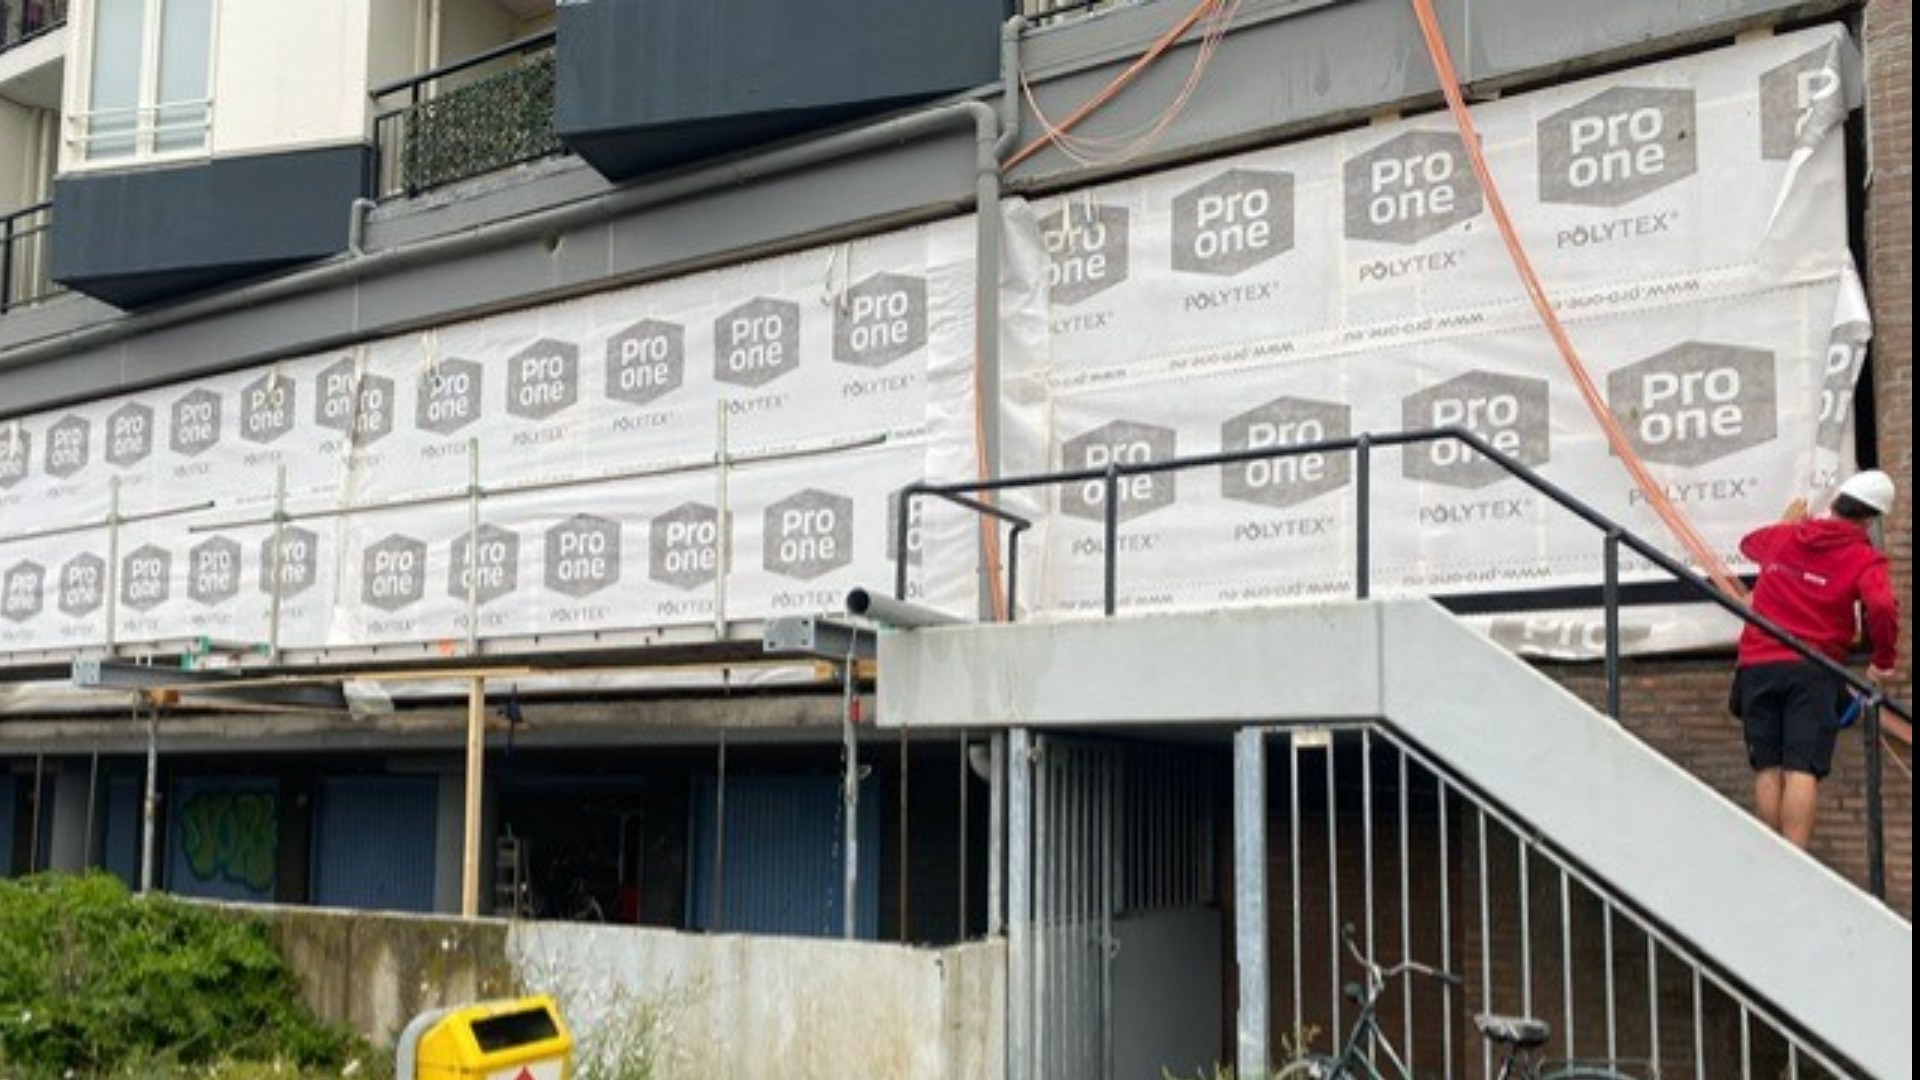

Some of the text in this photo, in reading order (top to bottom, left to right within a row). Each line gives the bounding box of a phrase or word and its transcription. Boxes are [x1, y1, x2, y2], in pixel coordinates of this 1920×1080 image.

[1568, 143, 1665, 187] one
[1367, 184, 1455, 224] one
[1193, 219, 1271, 258] one
[850, 319, 908, 351] one
[729, 341, 782, 371] one
[620, 362, 669, 391] one
[519, 381, 564, 406] one
[427, 397, 470, 420] one
[1640, 404, 1743, 445] one
[1245, 453, 1326, 487] one
[665, 546, 716, 573] one
[780, 534, 837, 563] one
[558, 556, 606, 580] one
[372, 572, 413, 597] one
